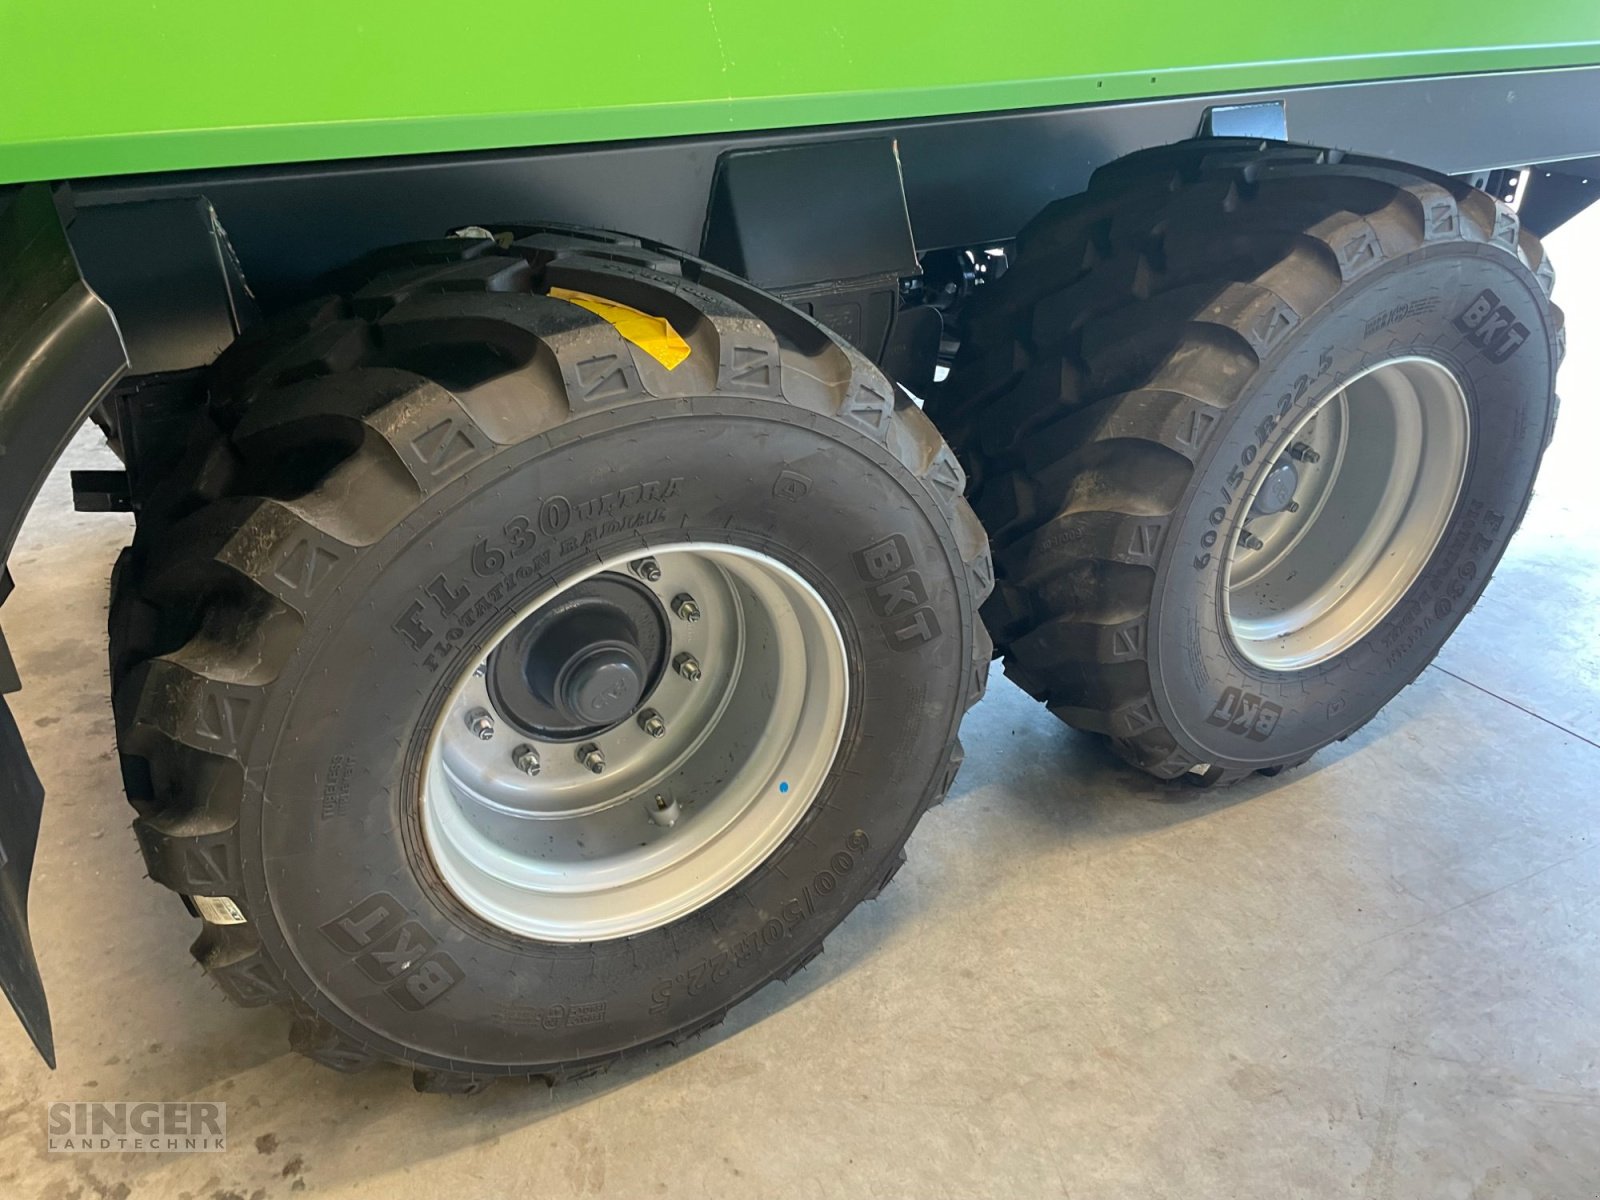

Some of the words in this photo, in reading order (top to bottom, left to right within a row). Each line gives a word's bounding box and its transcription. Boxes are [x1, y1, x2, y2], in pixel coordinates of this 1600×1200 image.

[1451, 288, 1531, 365] BKT
[391, 573, 474, 653] FL
[471, 495, 573, 580] 630
[422, 550, 551, 673] FLOTATION
[559, 507, 668, 557] RADIAL
[852, 532, 943, 653] BKT
[1205, 686, 1283, 743] BKT
[318, 893, 468, 1012] BKT
